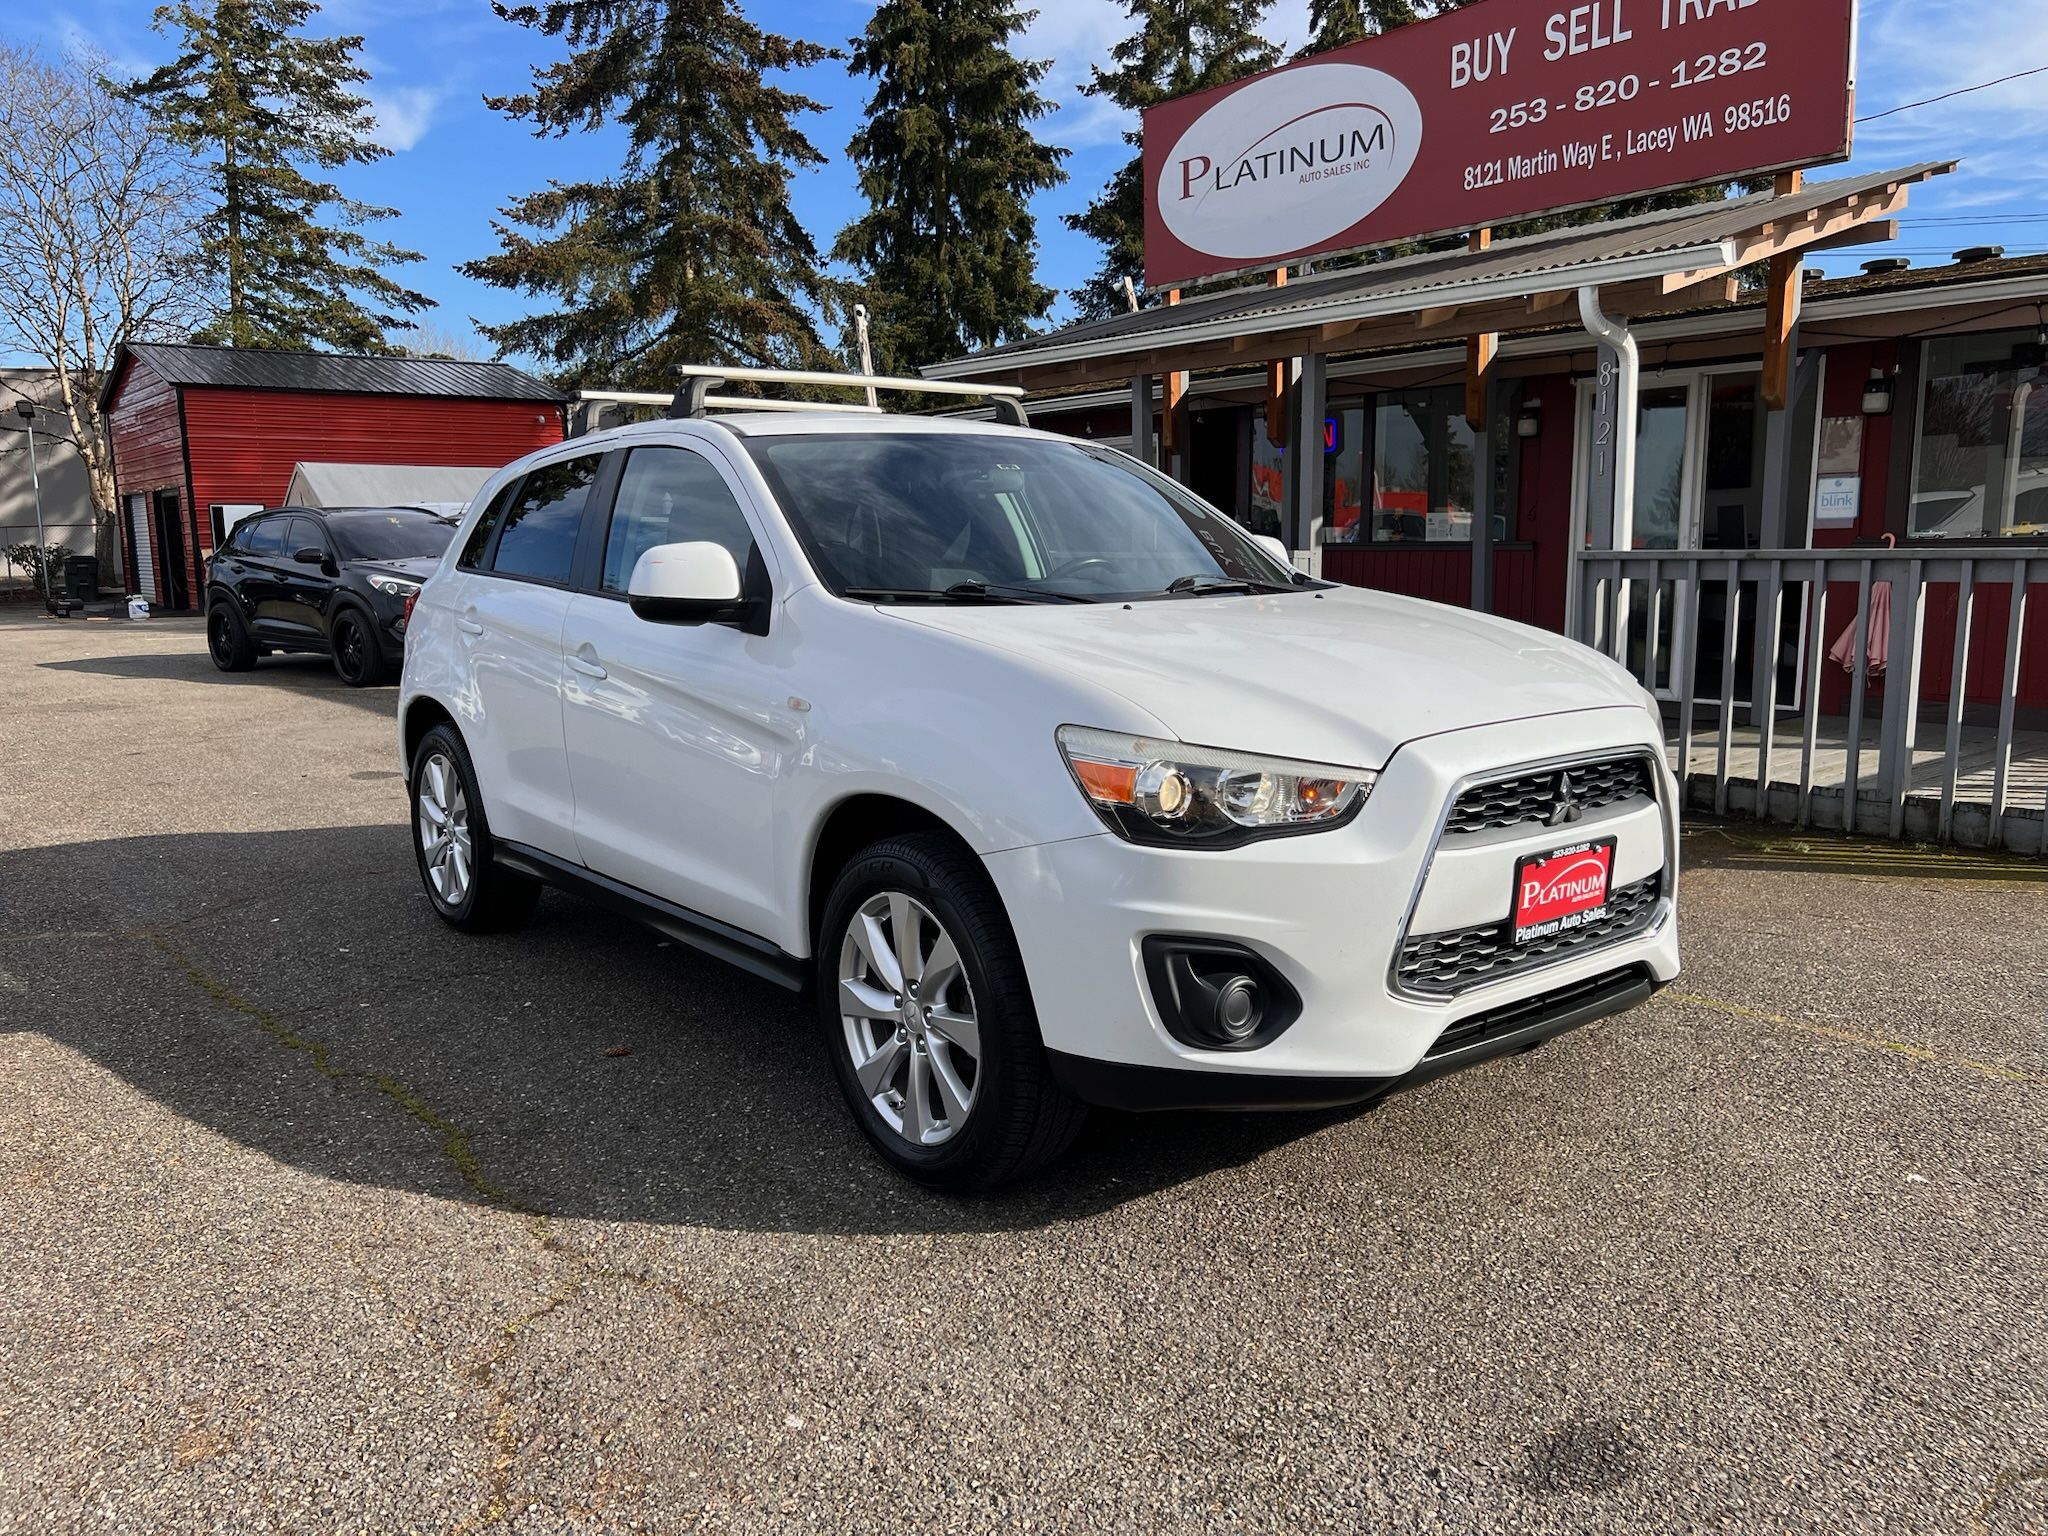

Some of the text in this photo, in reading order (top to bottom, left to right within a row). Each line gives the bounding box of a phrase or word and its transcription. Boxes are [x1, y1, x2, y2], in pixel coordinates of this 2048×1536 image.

[1450, 27, 1517, 90] BUY
[1543, 0, 1633, 62] SELL
[1489, 97, 1548, 134] 253
[1574, 74, 1640, 112] 820
[1670, 41, 1767, 89] 1282
[1178, 123, 1385, 201] PLATINUM
[1298, 158, 1370, 184] AUTO SALES INC
[1463, 159, 1504, 191] 8121
[1507, 149, 1557, 181] Martin
[1562, 141, 1597, 170] Way
[1626, 126, 1678, 155] Lacey
[1682, 111, 1714, 143] WA
[1724, 93, 1791, 134] 98516
[1595, 361, 1611, 476] 8121
[1821, 494, 1853, 507] blink
[1515, 907, 1606, 942] Platinum Auto Sales
[1521, 874, 1604, 909] PLATINUM
